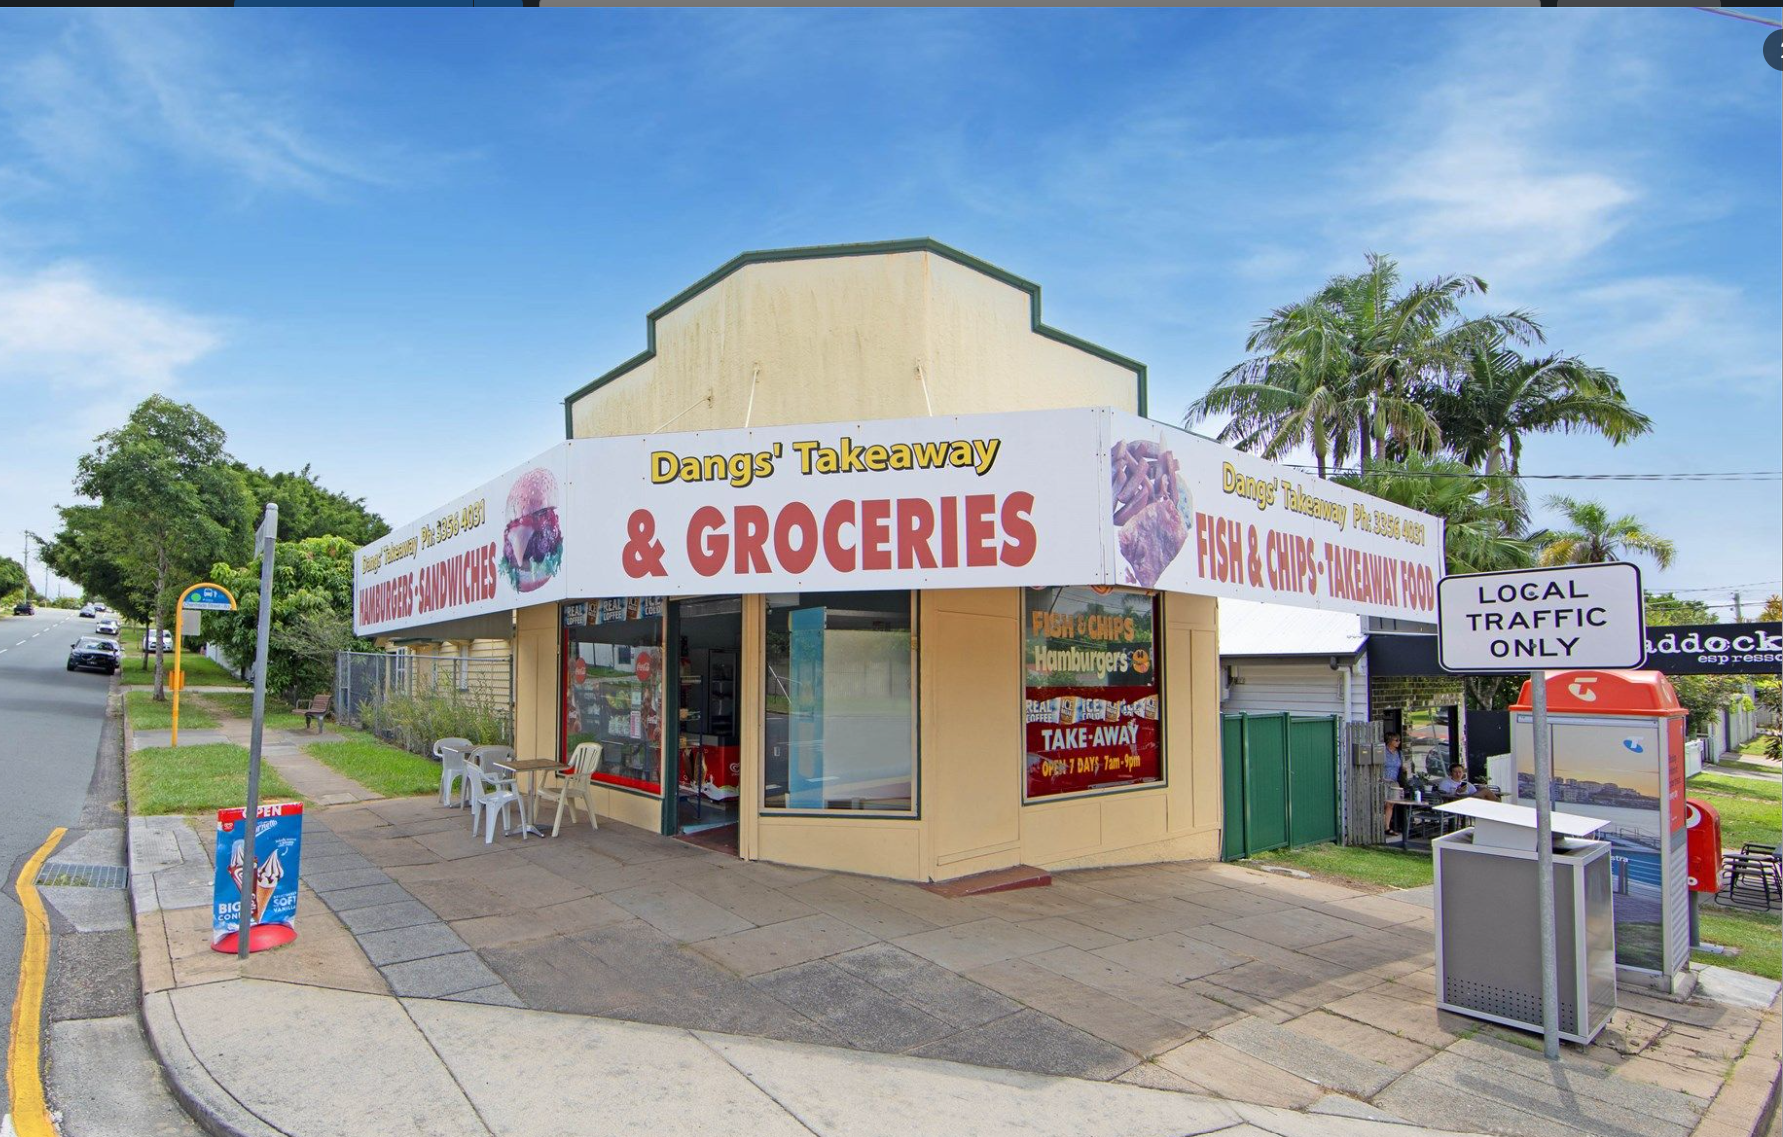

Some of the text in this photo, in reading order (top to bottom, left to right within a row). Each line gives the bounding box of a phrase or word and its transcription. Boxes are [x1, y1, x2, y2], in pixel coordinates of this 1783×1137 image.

[651, 437, 1001, 488] Dangs' Takeaway
[1223, 461, 1425, 546] Dangs' Takeaway Ph: 3356 4031
[384, 536, 418, 566] Takeaway
[421, 524, 435, 550] Ph:
[436, 512, 459, 543] 3356
[461, 498, 485, 532] 4031
[622, 490, 1037, 579] & GROCERIES
[1196, 512, 1434, 612] FISH & CHIPS TAKEAWAY FOOD
[359, 541, 497, 626] HAMBURGERS SANDWICHES
[1479, 580, 1589, 604] LOCAL
[603, 599, 621, 611] REAL
[1032, 610, 1135, 642] FISH & CHIPS
[1466, 606, 1607, 632] TRAFFIC
[1490, 637, 1580, 658] ONLY
[1645, 630, 1782, 653] addock
[1034, 646, 1128, 679] Hamburgers
[1026, 699, 1052, 713] REAL
[1026, 713, 1052, 723] COFFEE
[1082, 698, 1100, 713] ICE
[1041, 724, 1139, 751] TAKE-AWAY
[1042, 759, 1067, 777] OPEN
[1069, 758, 1075, 774] 7
[1077, 756, 1099, 773] DAYS
[273, 896, 296, 907] SOFT
[218, 913, 240, 921] CON
